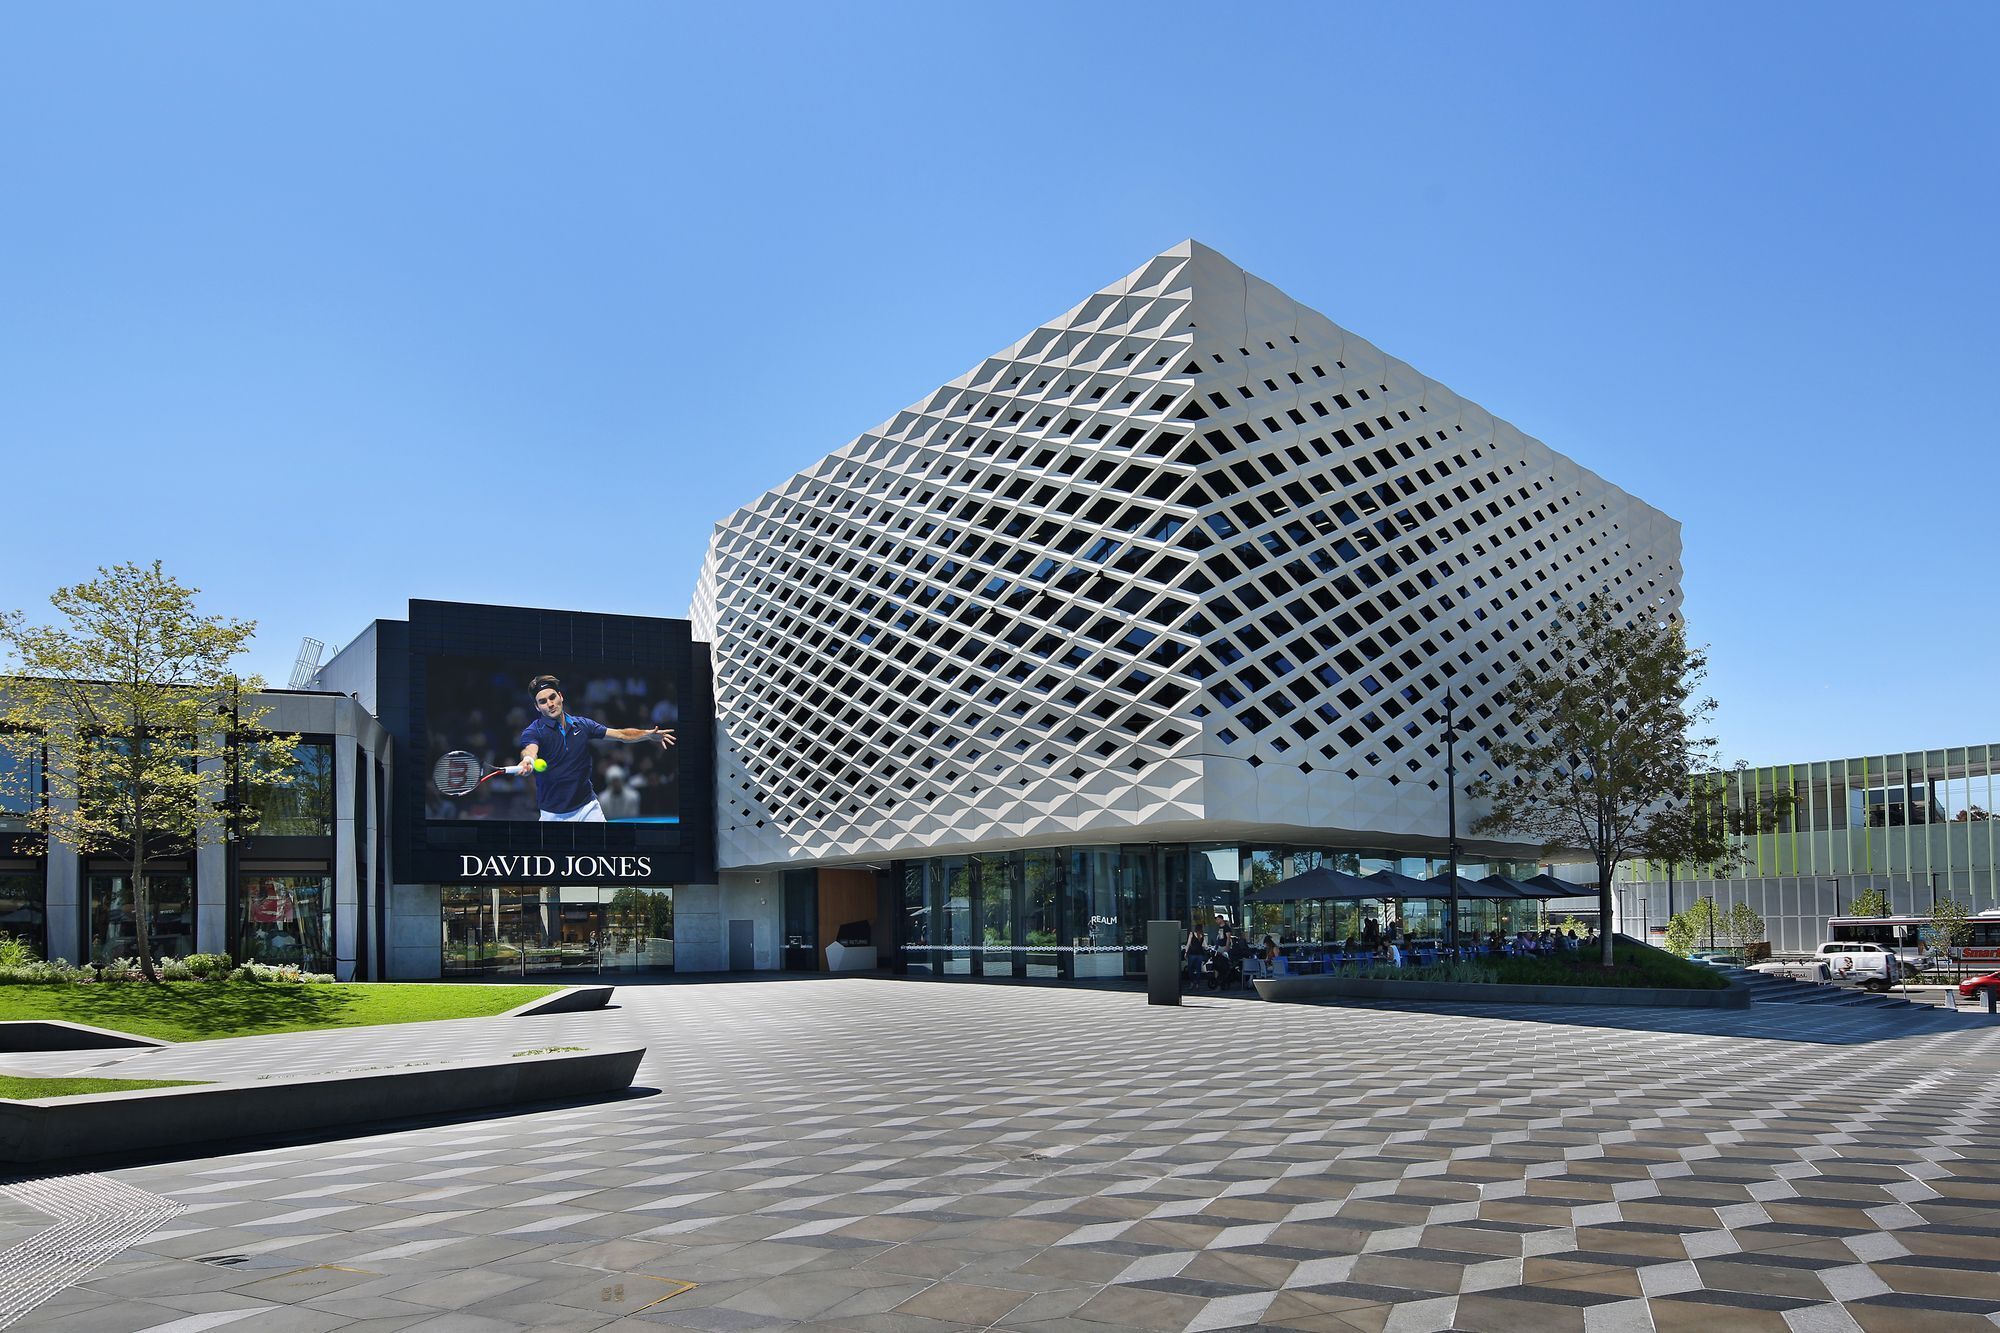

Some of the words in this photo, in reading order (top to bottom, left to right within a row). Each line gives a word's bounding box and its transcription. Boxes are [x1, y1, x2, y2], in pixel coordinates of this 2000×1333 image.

[460, 855, 555, 877] DAVID
[561, 856, 652, 877] JONES
[1091, 915, 1117, 925] REALM
